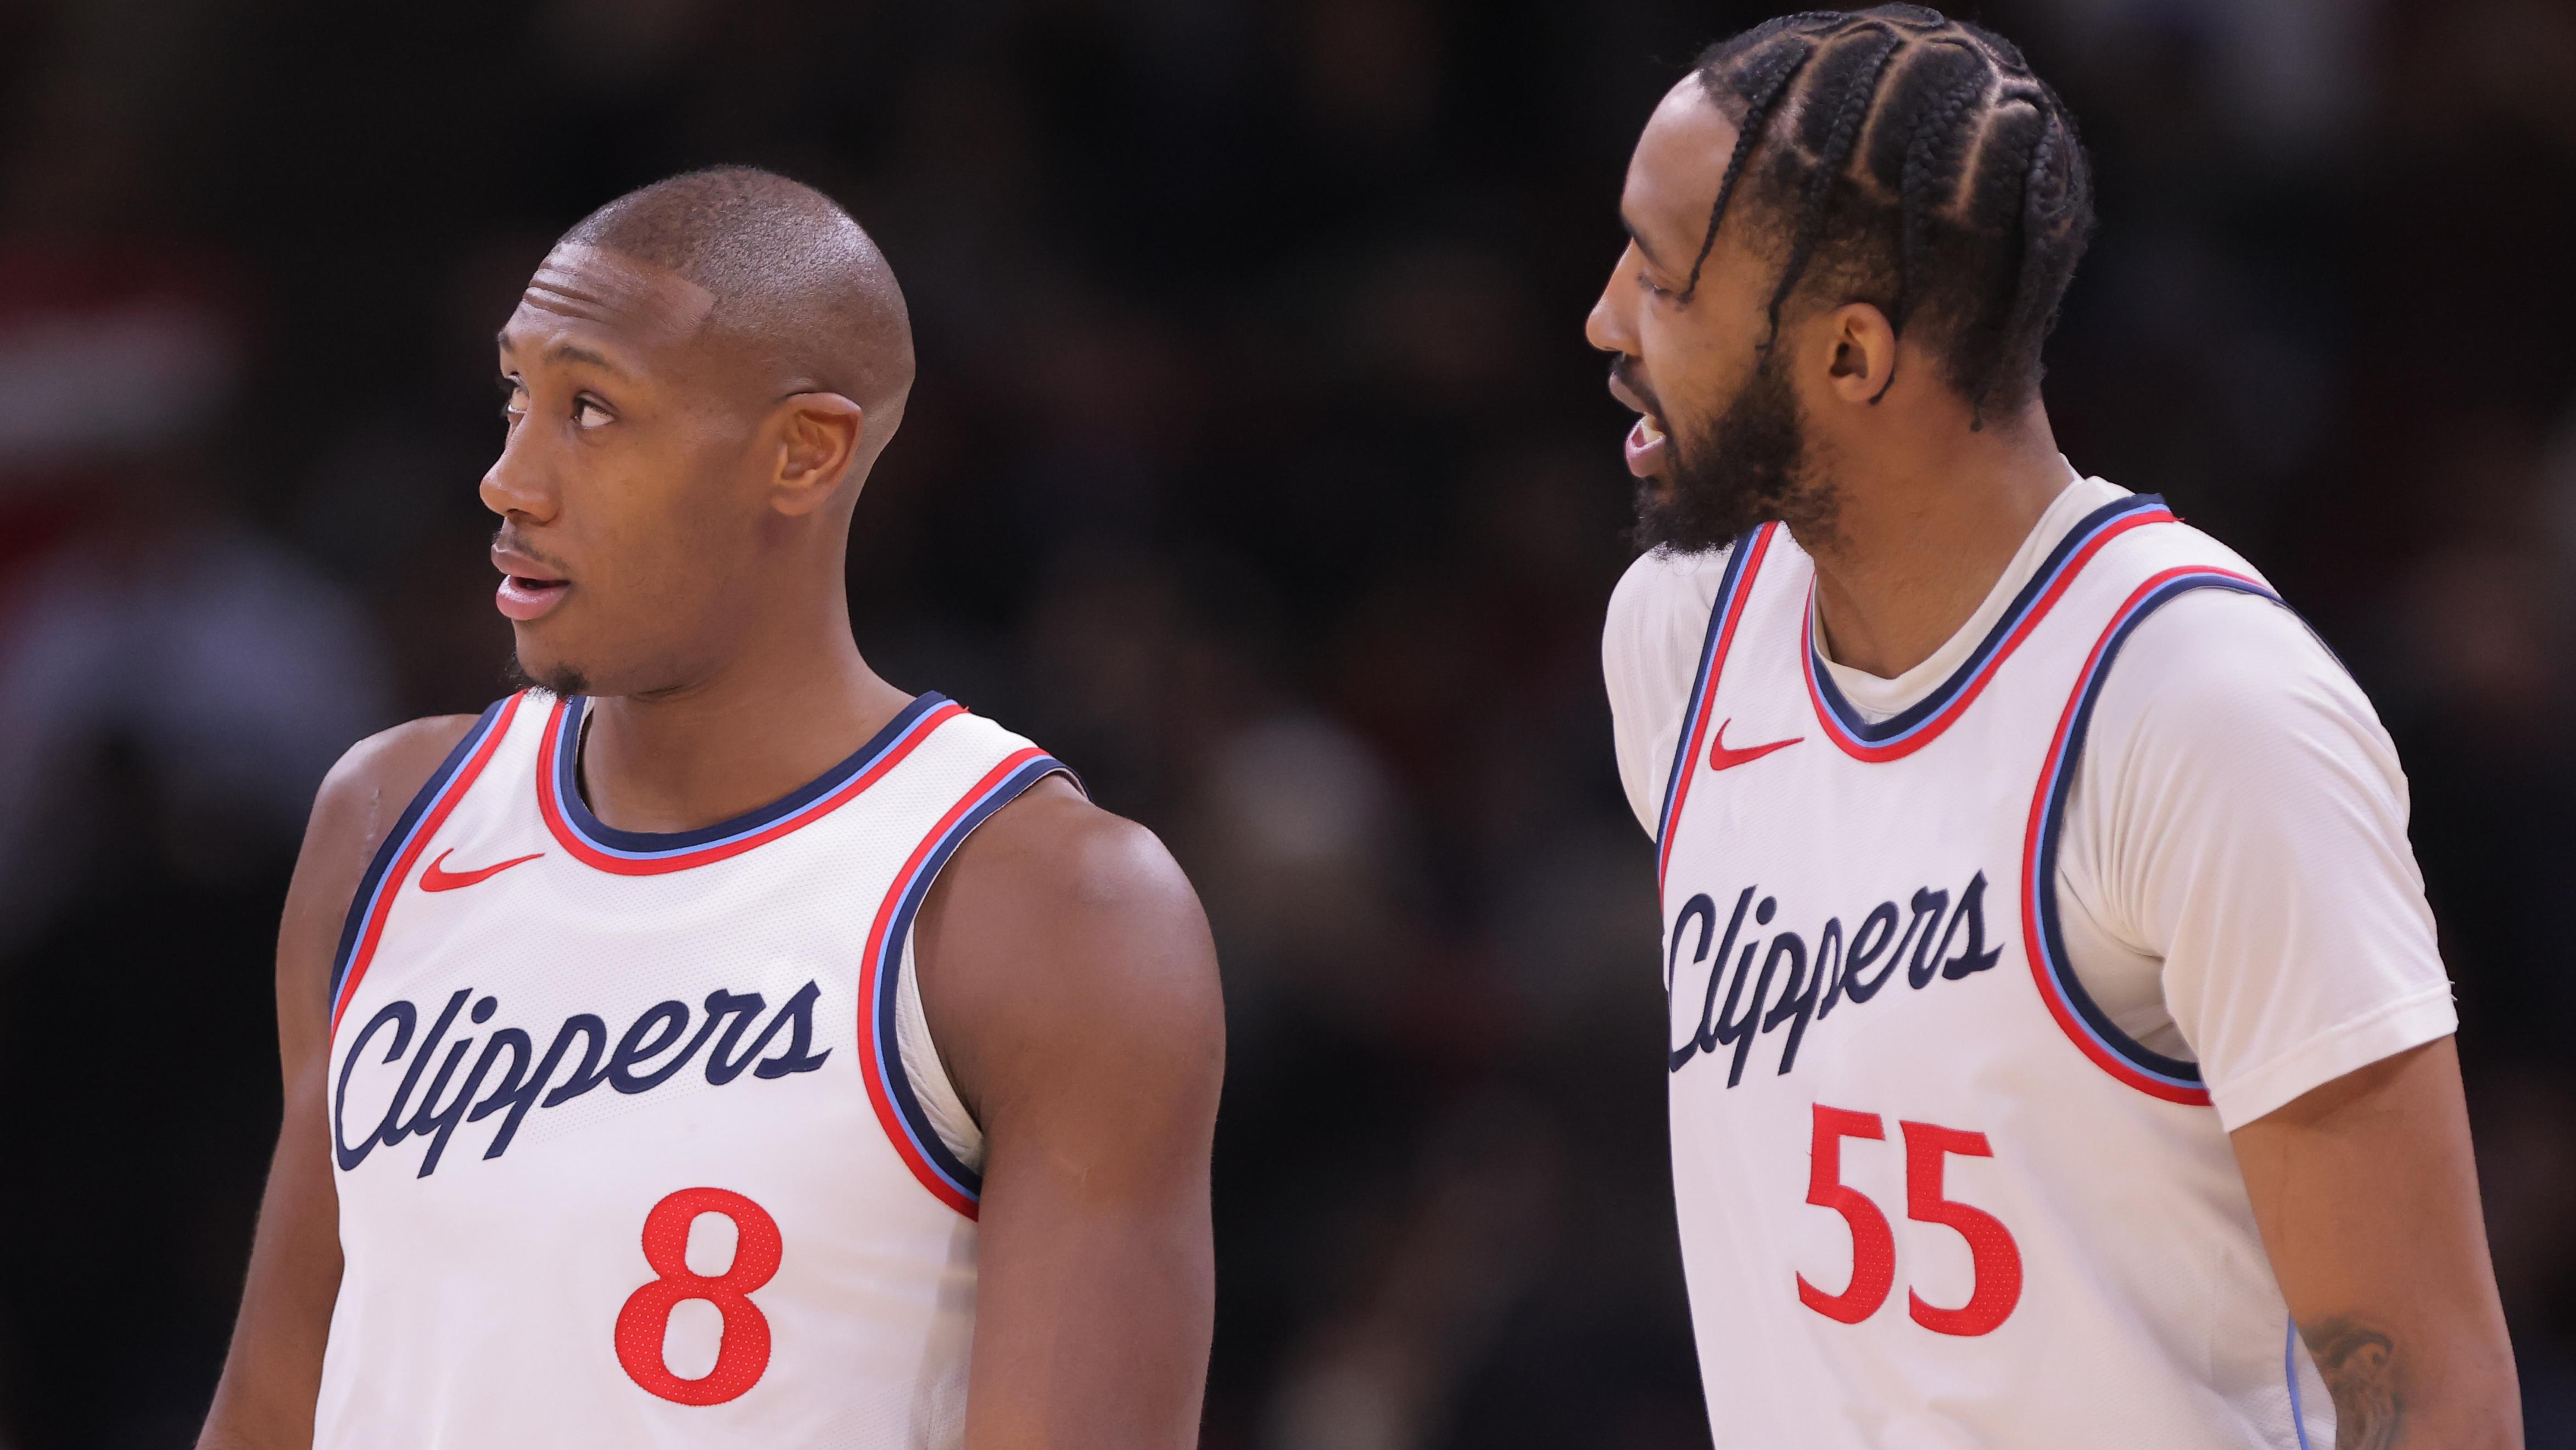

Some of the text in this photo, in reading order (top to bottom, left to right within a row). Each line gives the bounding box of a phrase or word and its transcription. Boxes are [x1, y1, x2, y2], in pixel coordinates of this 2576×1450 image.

[335, 979, 833, 1179] Clippers
[1668, 868, 2005, 1089] Clippers
[614, 1186, 784, 1407] 8
[1796, 1101, 2024, 1337] 55
